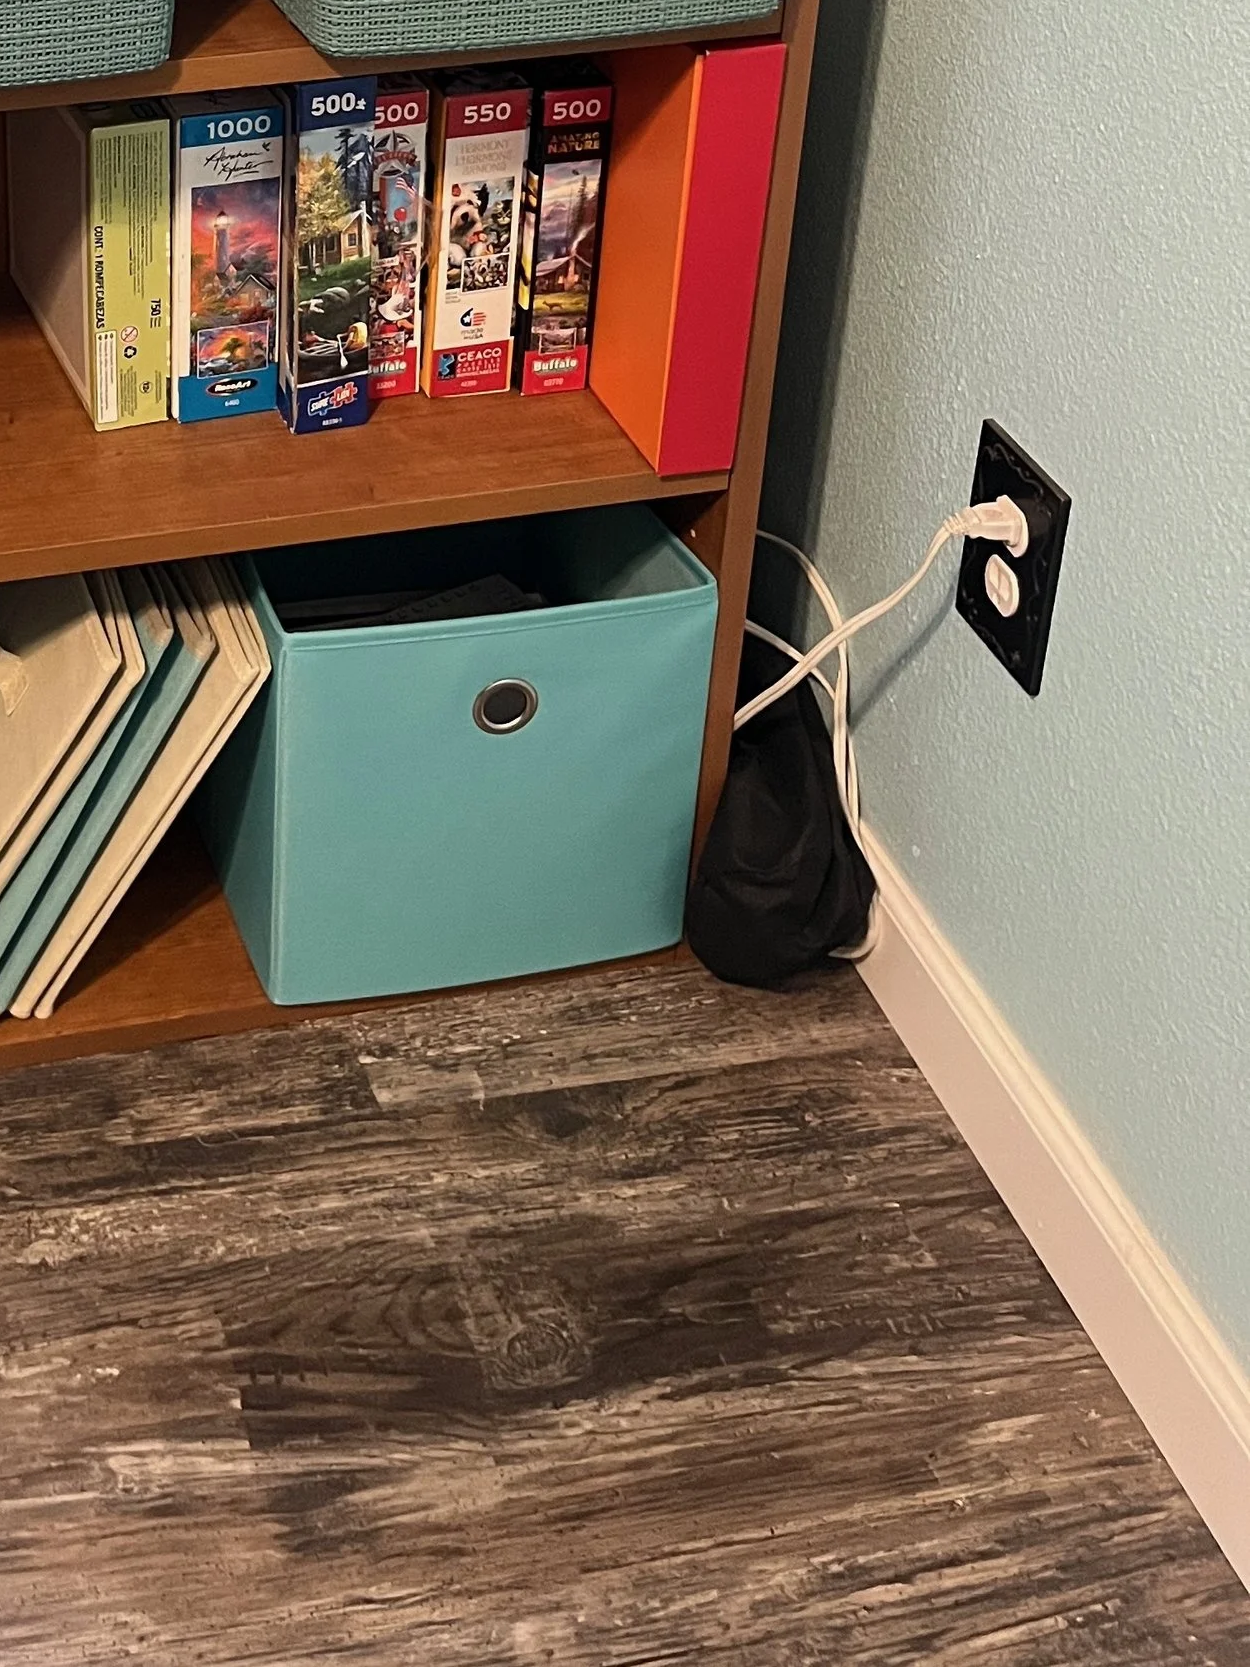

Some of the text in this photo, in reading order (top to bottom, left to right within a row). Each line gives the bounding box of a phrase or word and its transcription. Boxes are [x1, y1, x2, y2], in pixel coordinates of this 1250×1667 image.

[311, 92, 355, 117] 500
[374, 102, 419, 125] 500
[463, 102, 511, 124] 550
[552, 99, 601, 120] 500
[207, 115, 272, 140] 1000
[547, 140, 600, 154] NATURE
[94, 261, 105, 329] ROMPECABEZAS
[150, 298, 161, 316] 750
[457, 347, 502, 362] CEACO
[533, 356, 578, 372] Buffalo
